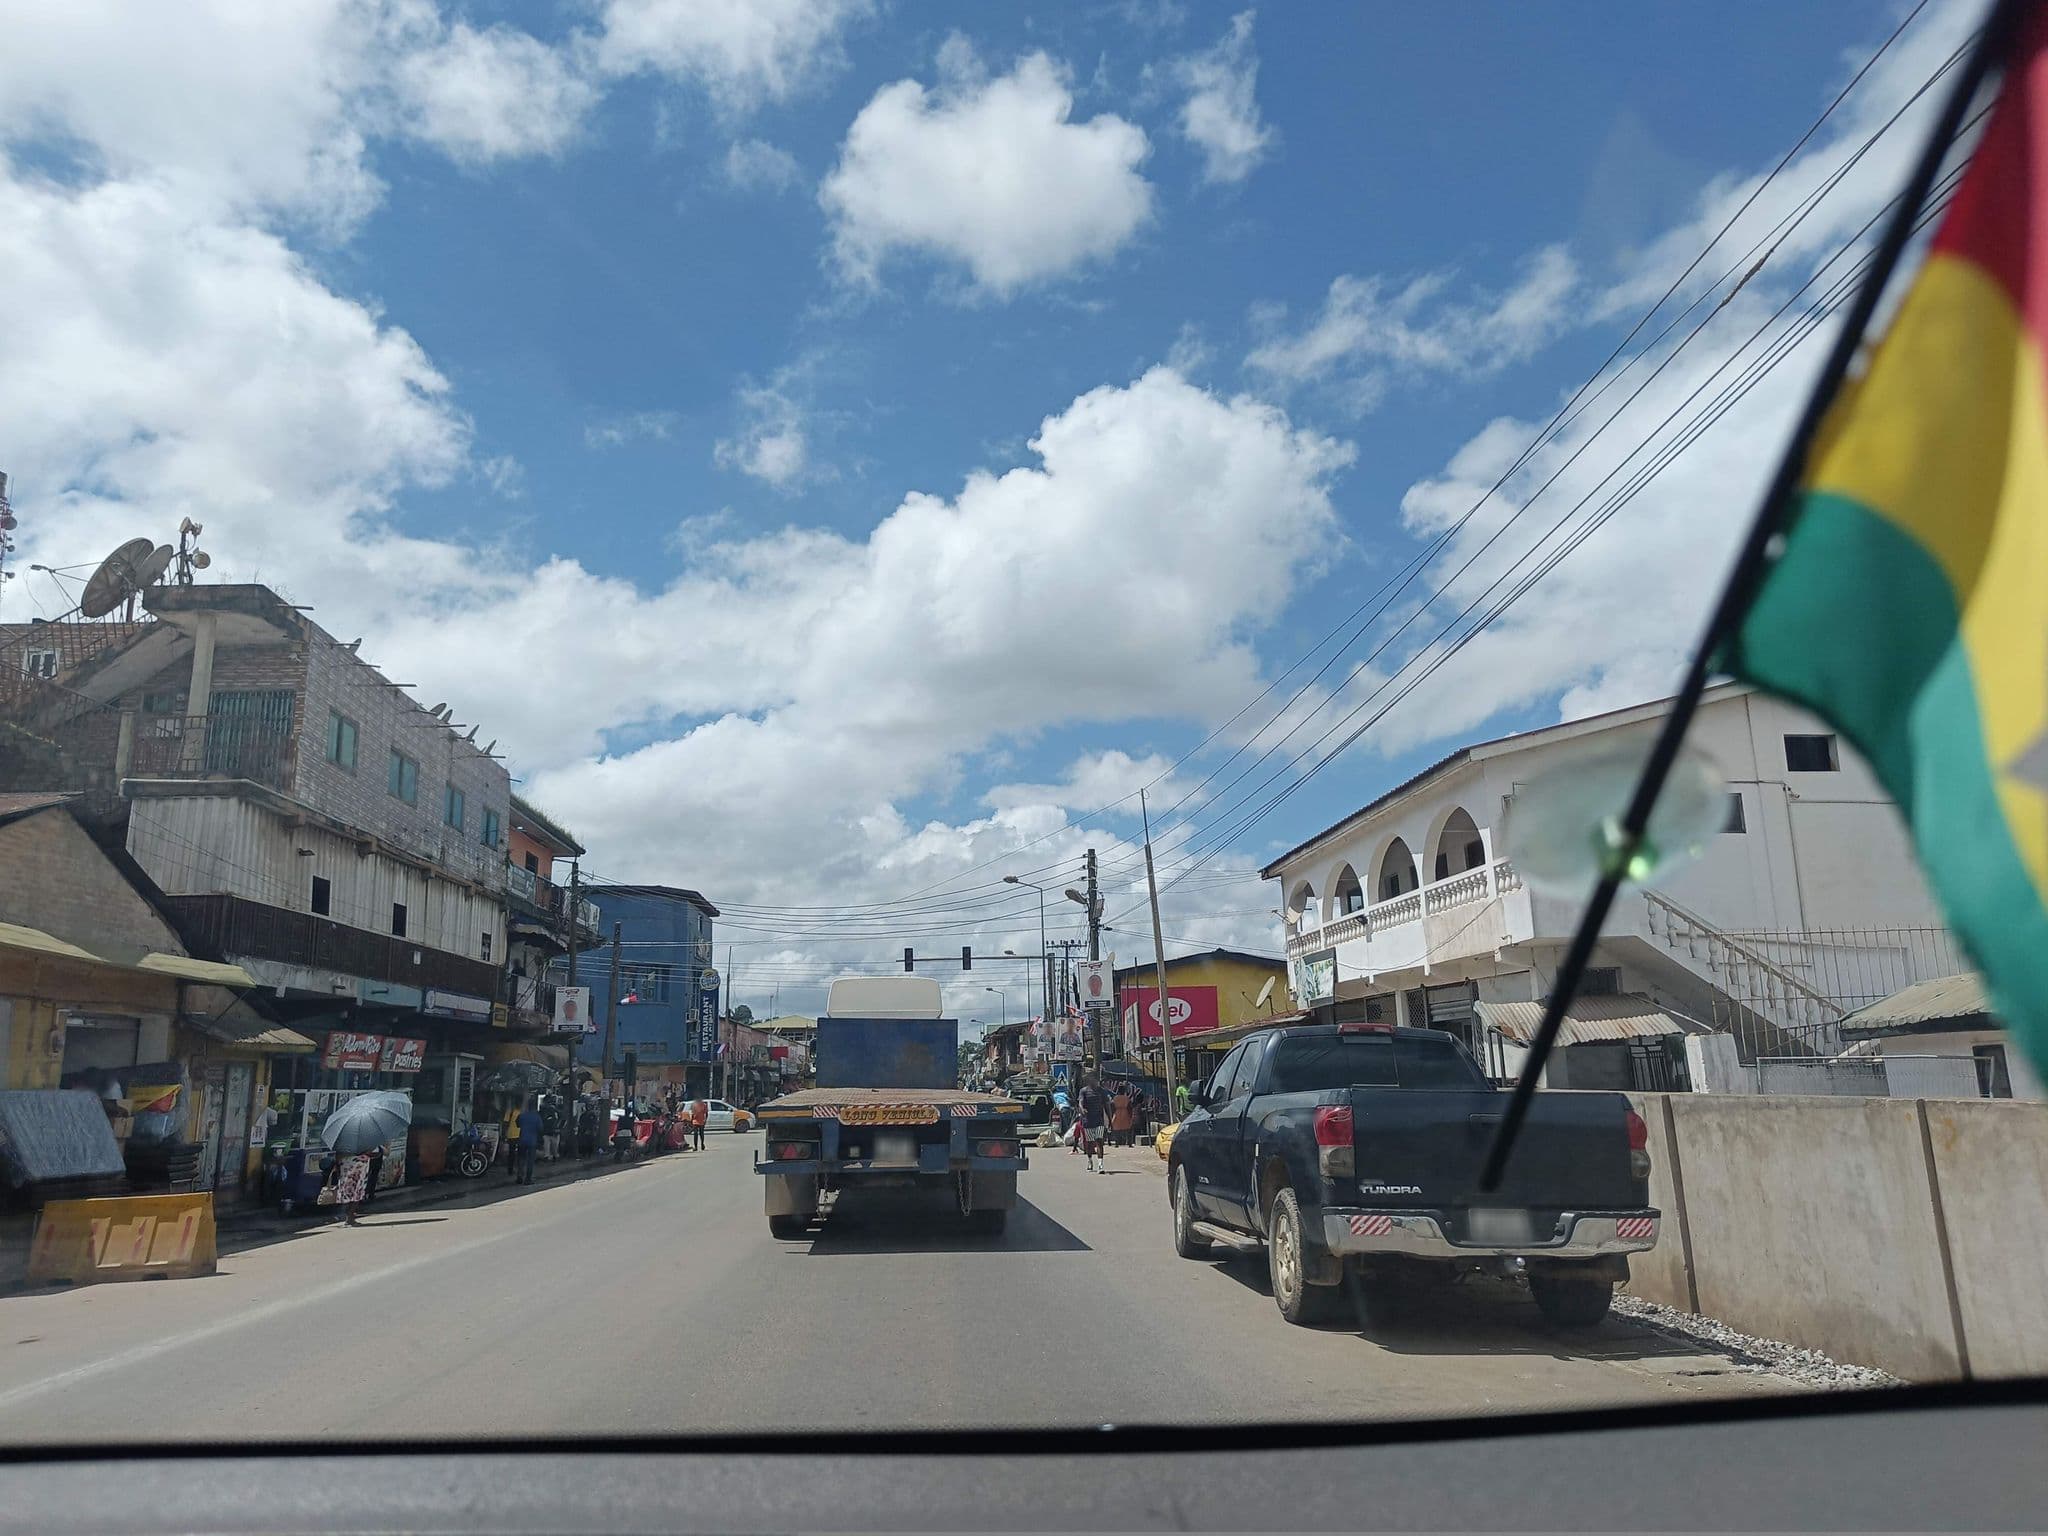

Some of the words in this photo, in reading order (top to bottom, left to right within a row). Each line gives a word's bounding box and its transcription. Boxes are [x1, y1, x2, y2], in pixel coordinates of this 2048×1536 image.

[1157, 1003, 1184, 1018] iel
[844, 1110, 877, 1120] LONG
[882, 1109, 935, 1120] VEHICLE
[1359, 1185, 1423, 1194] TUNDRA
